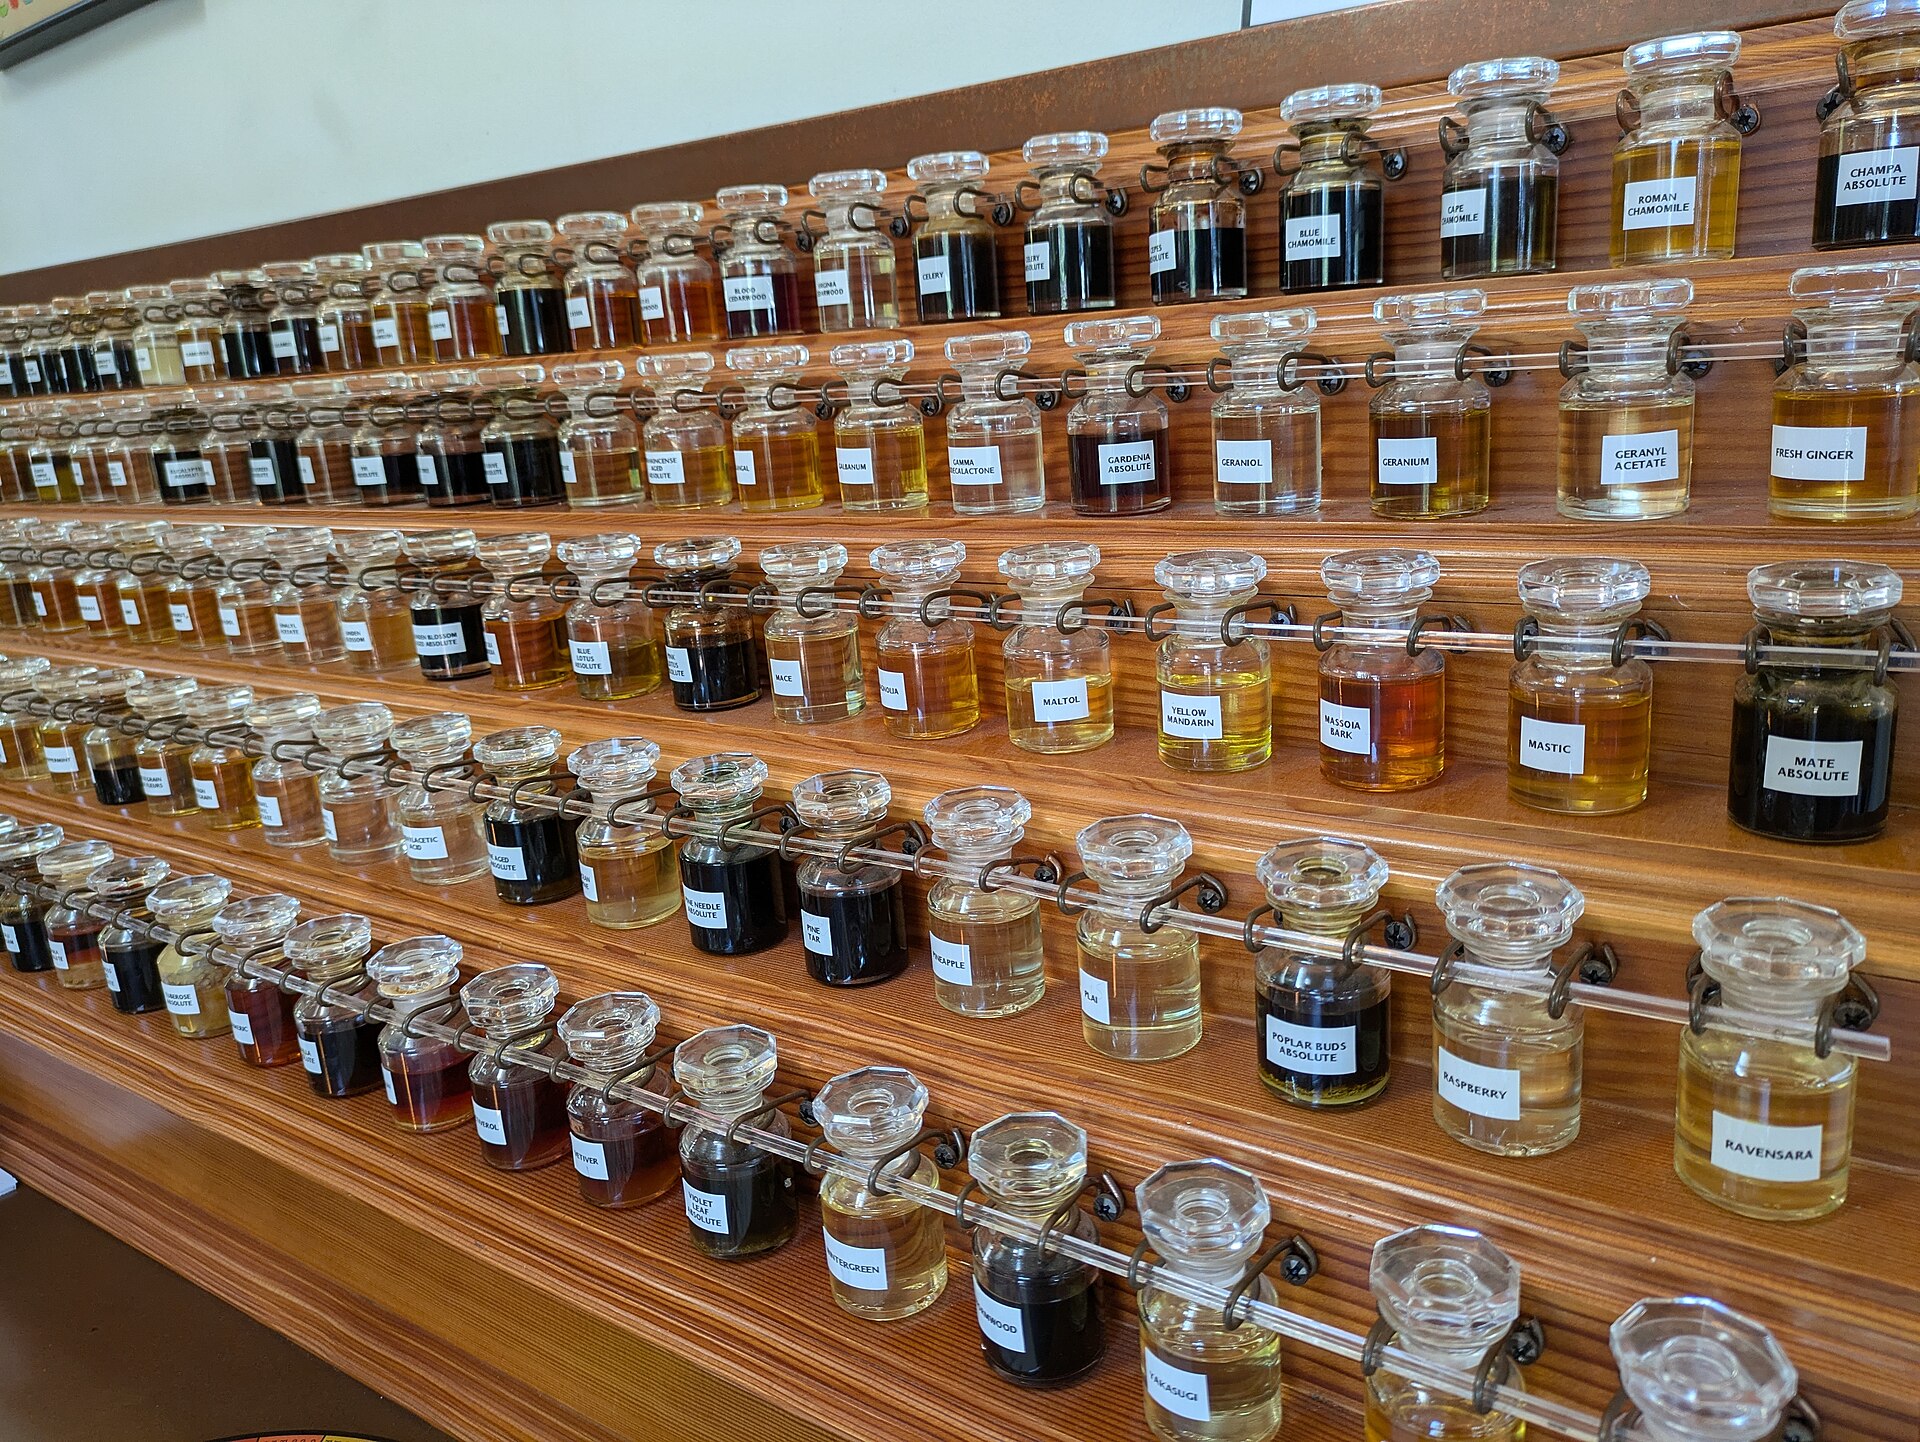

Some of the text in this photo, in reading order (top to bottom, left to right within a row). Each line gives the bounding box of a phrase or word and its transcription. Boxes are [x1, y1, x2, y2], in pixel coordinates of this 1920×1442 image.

[1850, 164, 1902, 178] CHAMPA
[1843, 175, 1907, 191] ABSOLUTE
[1638, 193, 1677, 204] ROMAN
[1447, 204, 1464, 214] CAPE
[1627, 203, 1690, 216] CHAMOMILE
[1299, 228, 1320, 238] BLUE
[1287, 237, 1336, 249] CHAMOMILE
[922, 271, 944, 281] CELERY
[734, 287, 756, 295] BLOOD
[1107, 452, 1151, 465] GARDENIA
[1614, 446, 1668, 460] GERANYL
[1775, 447, 1854, 461] FRESH GINGER
[1107, 462, 1152, 474] ABSOLUTE
[1221, 457, 1263, 468] GERANIOL
[1381, 456, 1430, 467] GERANIUM
[1614, 458, 1667, 471] ACETATE
[775, 674, 793, 683] MACE
[1043, 695, 1081, 707] MALTOL
[1171, 706, 1207, 717] YELLOW
[1166, 715, 1215, 727] MANDARIN
[1324, 714, 1361, 730] MASSOIA
[1330, 727, 1353, 740] BARK
[1528, 738, 1572, 754] MASTIC
[1794, 756, 1836, 769] MATE
[1777, 766, 1850, 782] ABSOLUTE
[694, 900, 721, 911] NEEDLE
[806, 923, 820, 935] PINE
[807, 933, 821, 944] TAR
[1272, 1031, 1347, 1052] POPLAR BUDS
[1279, 1046, 1338, 1063] ABSOLUTE
[1443, 1071, 1507, 1100] RASPBERRY
[1725, 1138, 1814, 1161] RAVENSARA
[688, 1191, 713, 1208] VIOLET
[691, 1203, 709, 1216] LEAF
